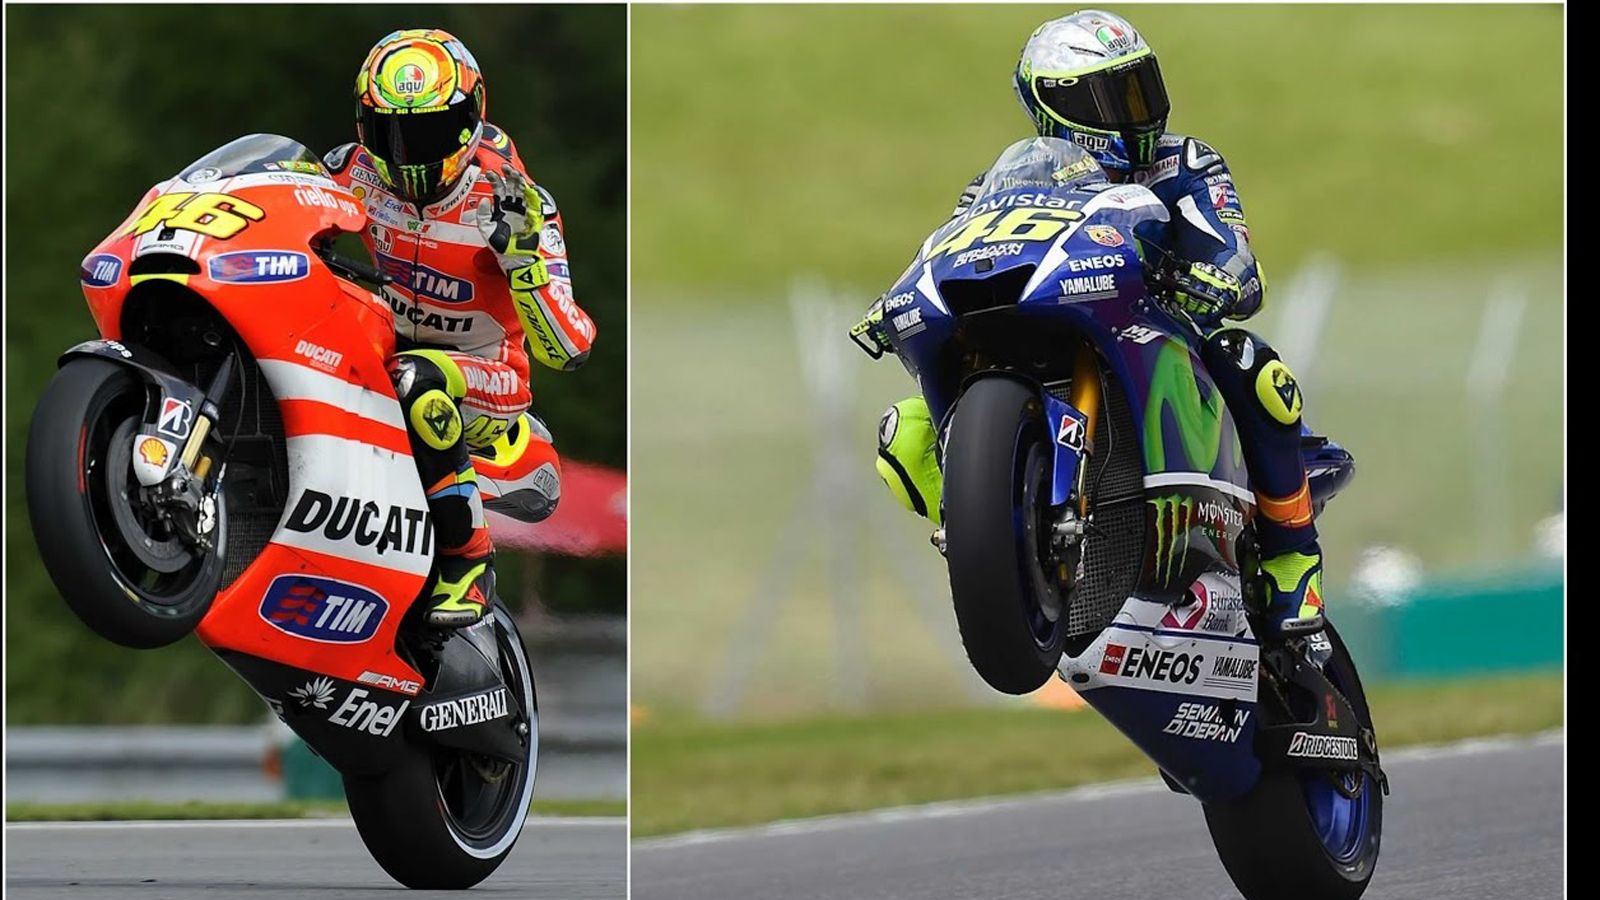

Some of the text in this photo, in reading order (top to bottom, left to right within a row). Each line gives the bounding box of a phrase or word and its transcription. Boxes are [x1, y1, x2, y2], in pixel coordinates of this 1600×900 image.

[1108, 36, 1128, 50] agv
[398, 81, 422, 93] agv
[1076, 133, 1109, 150] agv
[294, 184, 360, 217] riello ups
[120, 192, 265, 240] 46
[924, 207, 1085, 261] 46
[93, 260, 119, 282] TIM
[255, 256, 298, 275] TIM
[1069, 254, 1125, 273] ENEOS
[412, 270, 460, 300] TIM
[1060, 274, 1116, 295] YAMALUBE
[376, 285, 474, 332] DUCATI
[885, 291, 916, 313] ENEOS
[295, 339, 344, 368] DUCATI
[463, 366, 518, 396] DUCATI
[285, 488, 433, 556] DUCATI
[1198, 500, 1245, 530] MONSTER
[315, 595, 378, 634] TIM
[1202, 611, 1232, 631] Bank
[1121, 647, 1204, 685] ENEOS
[1212, 656, 1257, 680] YAMALUBE
[328, 687, 410, 738] Enel
[420, 688, 509, 732] GENERALI
[1182, 722, 1242, 743] DEPAN
[1287, 731, 1358, 760] BRIDGESTONE
